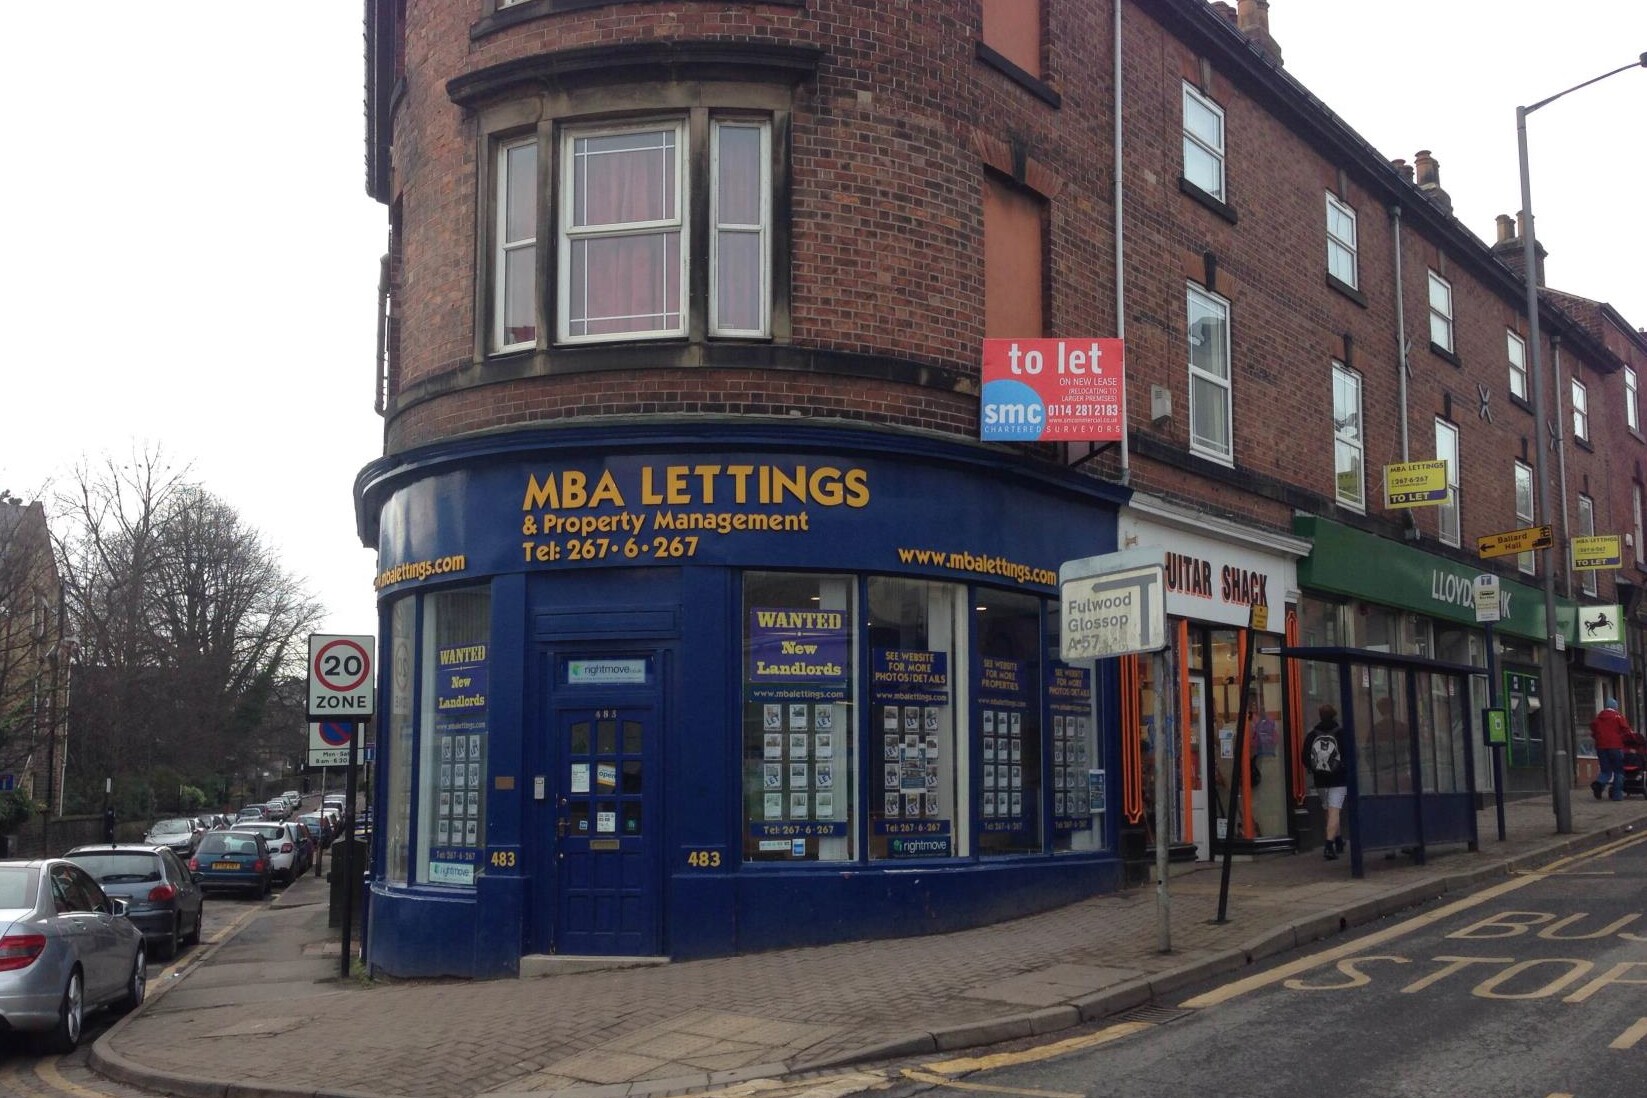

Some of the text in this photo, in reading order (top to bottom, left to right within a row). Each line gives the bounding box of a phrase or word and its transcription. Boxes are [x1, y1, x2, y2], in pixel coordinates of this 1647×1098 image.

[1008, 342, 1102, 375] to let
[1059, 377, 1118, 386] ON NEW LEASE
[984, 403, 1042, 424] smc
[1048, 404, 1072, 416] 0114
[984, 425, 1121, 433] CHARTERED SURVEYORS
[1408, 462, 1444, 471] LETTINGS
[522, 465, 870, 511] MBA LETTINGS
[1391, 491, 1430, 503] TO LET
[522, 509, 809, 537] & Property Management
[522, 541, 561, 562] Tel:
[898, 547, 1057, 586] www.mbalettings.com
[1577, 558, 1608, 567] TO LET
[1164, 551, 1268, 606] UITAR SHACK
[1431, 568, 1475, 609] LLOYD
[1068, 591, 1132, 615] Fulwood
[757, 611, 842, 630] WANTED
[1068, 614, 1129, 633] Glossop
[440, 645, 486, 665] WANTED
[781, 640, 818, 655] New
[885, 651, 935, 662] SEE WEBSITE
[324, 655, 362, 677] 20
[756, 661, 842, 676] Landlords
[888, 661, 932, 673] FOR MORE
[451, 675, 472, 688] New
[315, 695, 368, 709] ZONE
[438, 693, 485, 709] Landlords
[903, 840, 947, 854] rightmove
[490, 851, 516, 868] 483
[687, 851, 722, 868] 483
[1444, 910, 1647, 942] BU
